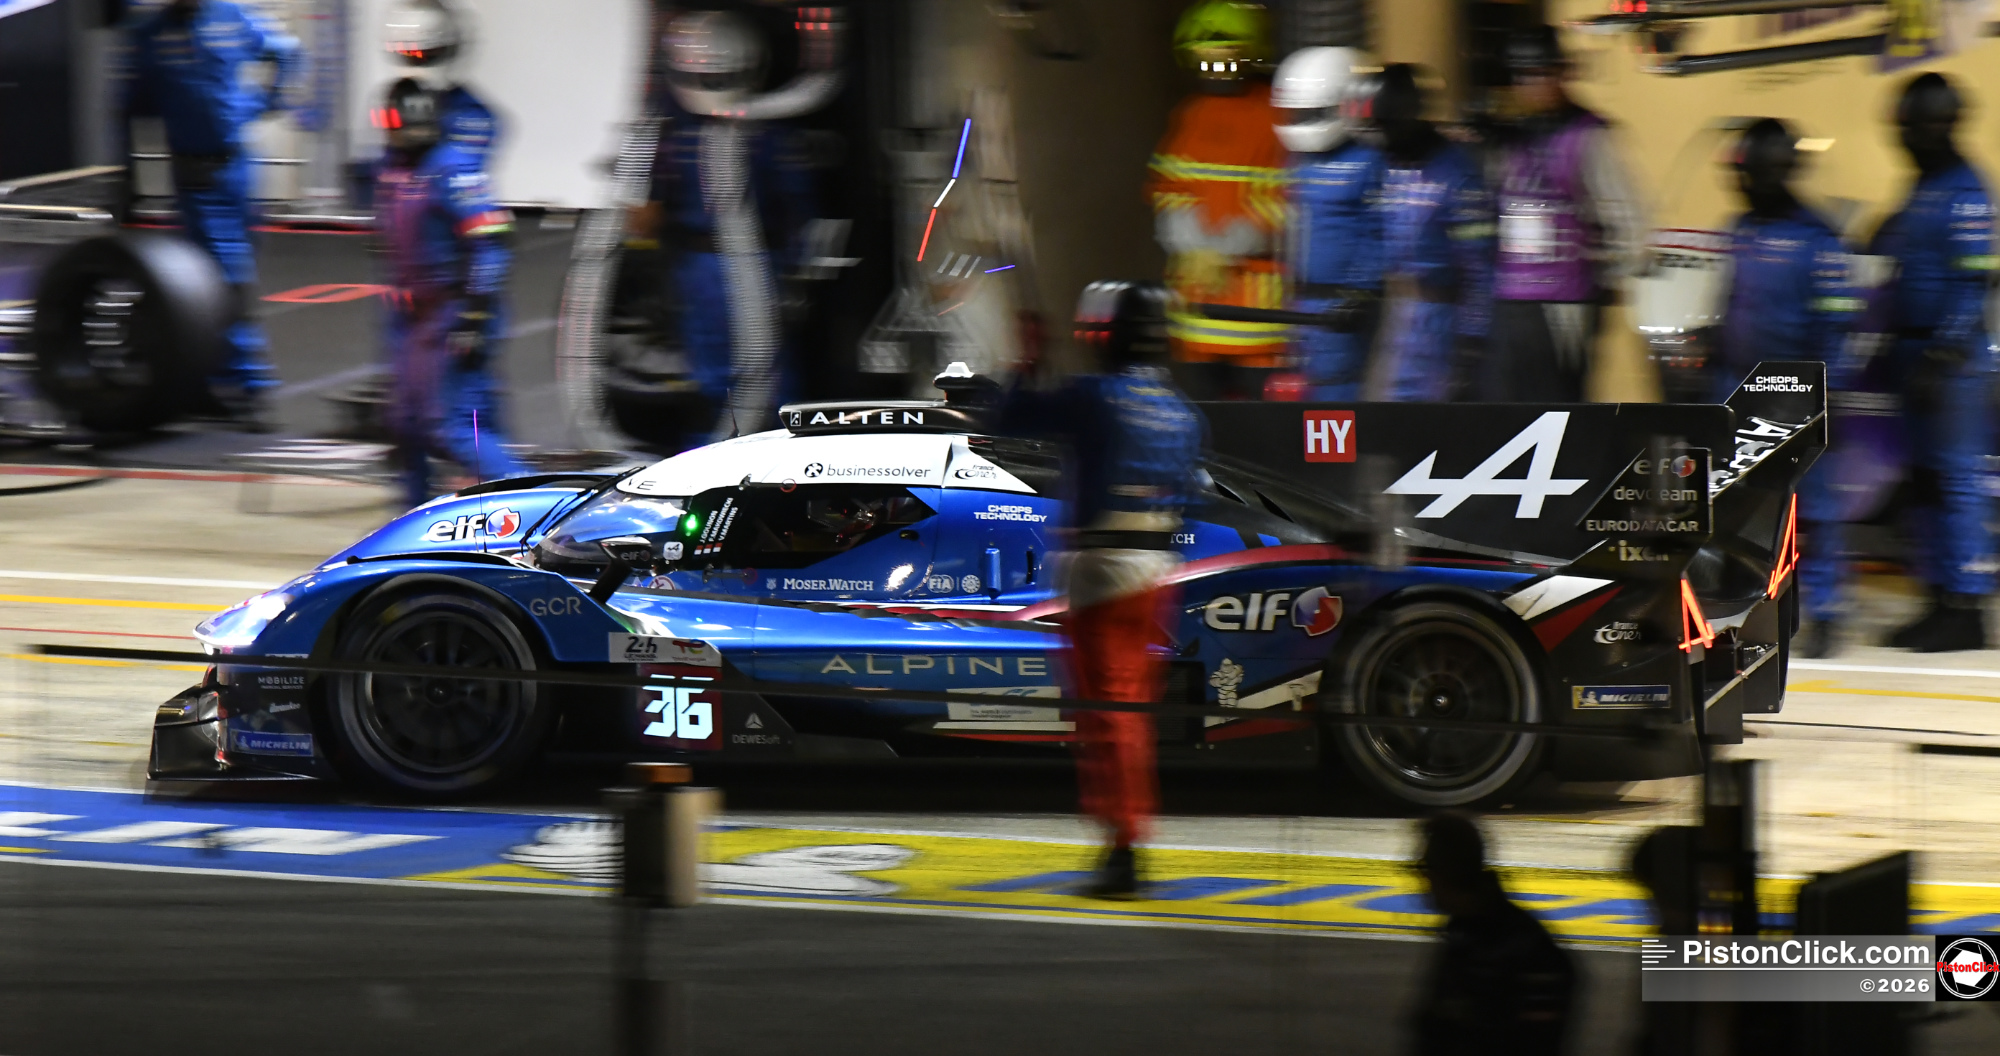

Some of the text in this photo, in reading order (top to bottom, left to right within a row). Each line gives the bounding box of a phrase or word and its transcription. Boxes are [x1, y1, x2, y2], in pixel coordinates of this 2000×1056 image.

[1756, 376, 1798, 384] CHEOPS
[1743, 384, 1813, 392] TECHNOLOGY
[810, 412, 924, 424] ALTEN
[1306, 419, 1353, 454] HY
[827, 464, 931, 478] businessolver
[1633, 458, 1670, 475] ef
[1613, 486, 1698, 501] devoeam
[987, 504, 1033, 514] CHEOPS
[974, 512, 1047, 522] TECHNOLOGY
[427, 514, 485, 542] elf
[699, 510, 718, 543] J.GOUNON
[783, 578, 874, 591] MOSER.WATCH
[929, 576, 951, 590] FIA
[530, 597, 582, 617] GCR
[1204, 593, 1290, 631] elf
[820, 654, 1048, 676] ALPINE
[642, 673, 714, 740] 36
[250, 740, 311, 750] MICHELIN
[732, 734, 780, 745] DEWESoft
